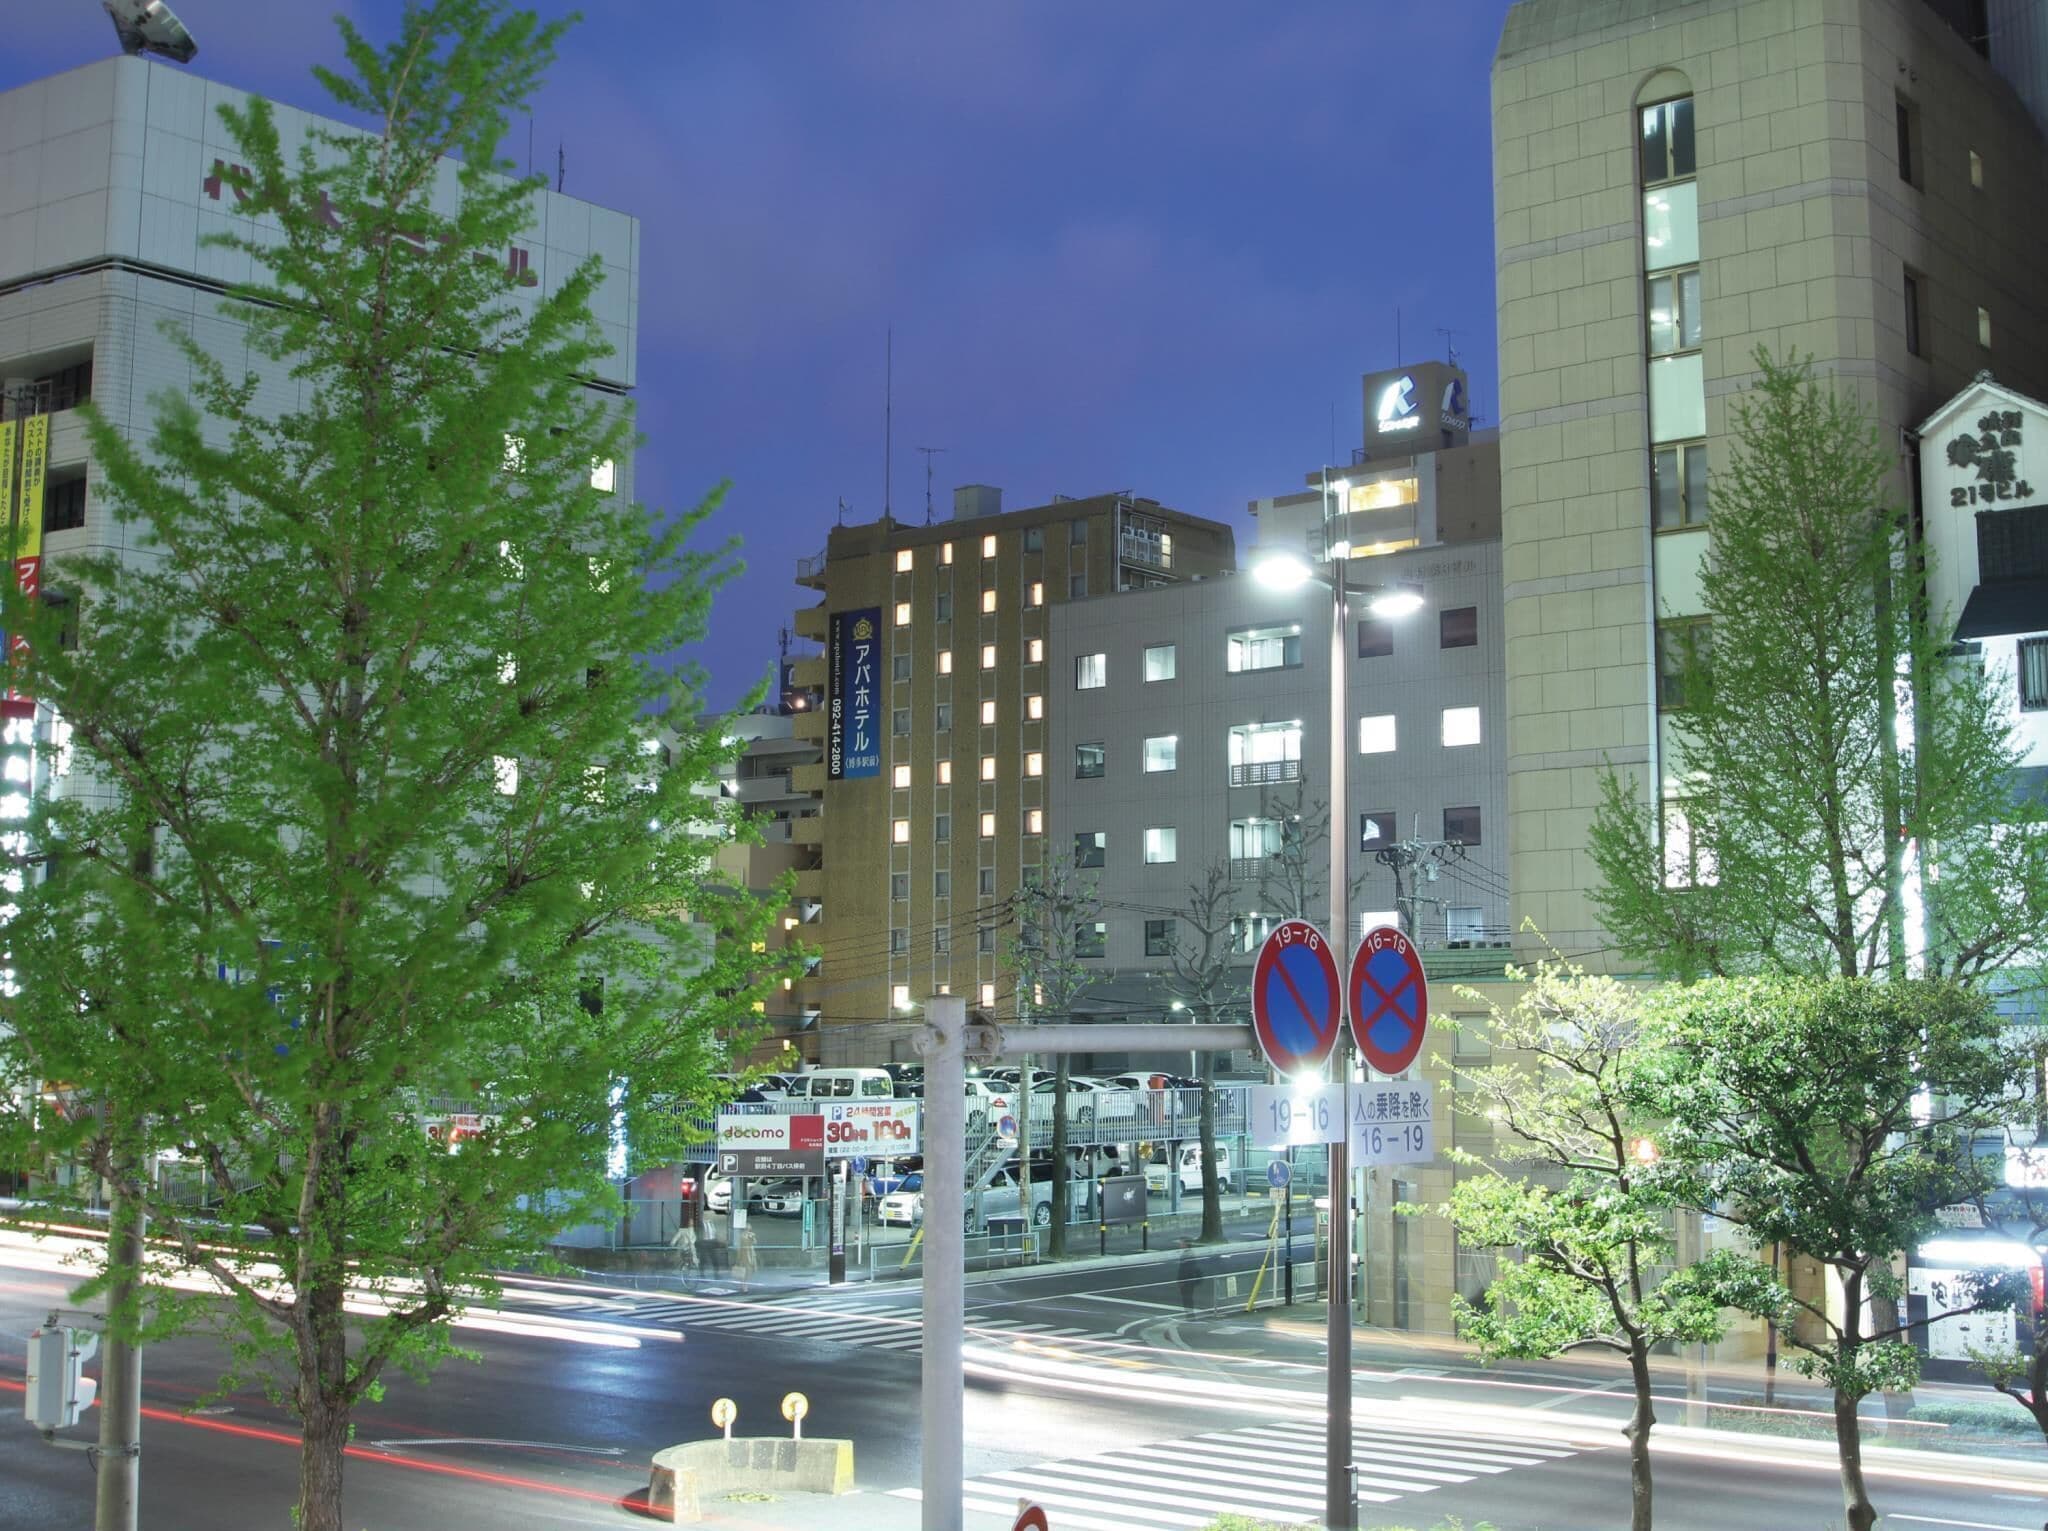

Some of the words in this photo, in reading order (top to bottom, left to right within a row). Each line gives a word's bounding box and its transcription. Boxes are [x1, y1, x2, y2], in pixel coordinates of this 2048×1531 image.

[1950, 479, 2035, 508] 21号ビル
[854, 644, 871, 752] アパホテル
[831, 698, 842, 775] 092-414-2800
[1274, 925, 1320, 951] 19-16
[1367, 931, 1407, 955] 16-19
[1269, 1096, 1330, 1134] 19-16
[1354, 1090, 1430, 1121] 人の乗降を除く
[724, 1126, 785, 1138] docomo
[1361, 1124, 1424, 1156] 16-19
